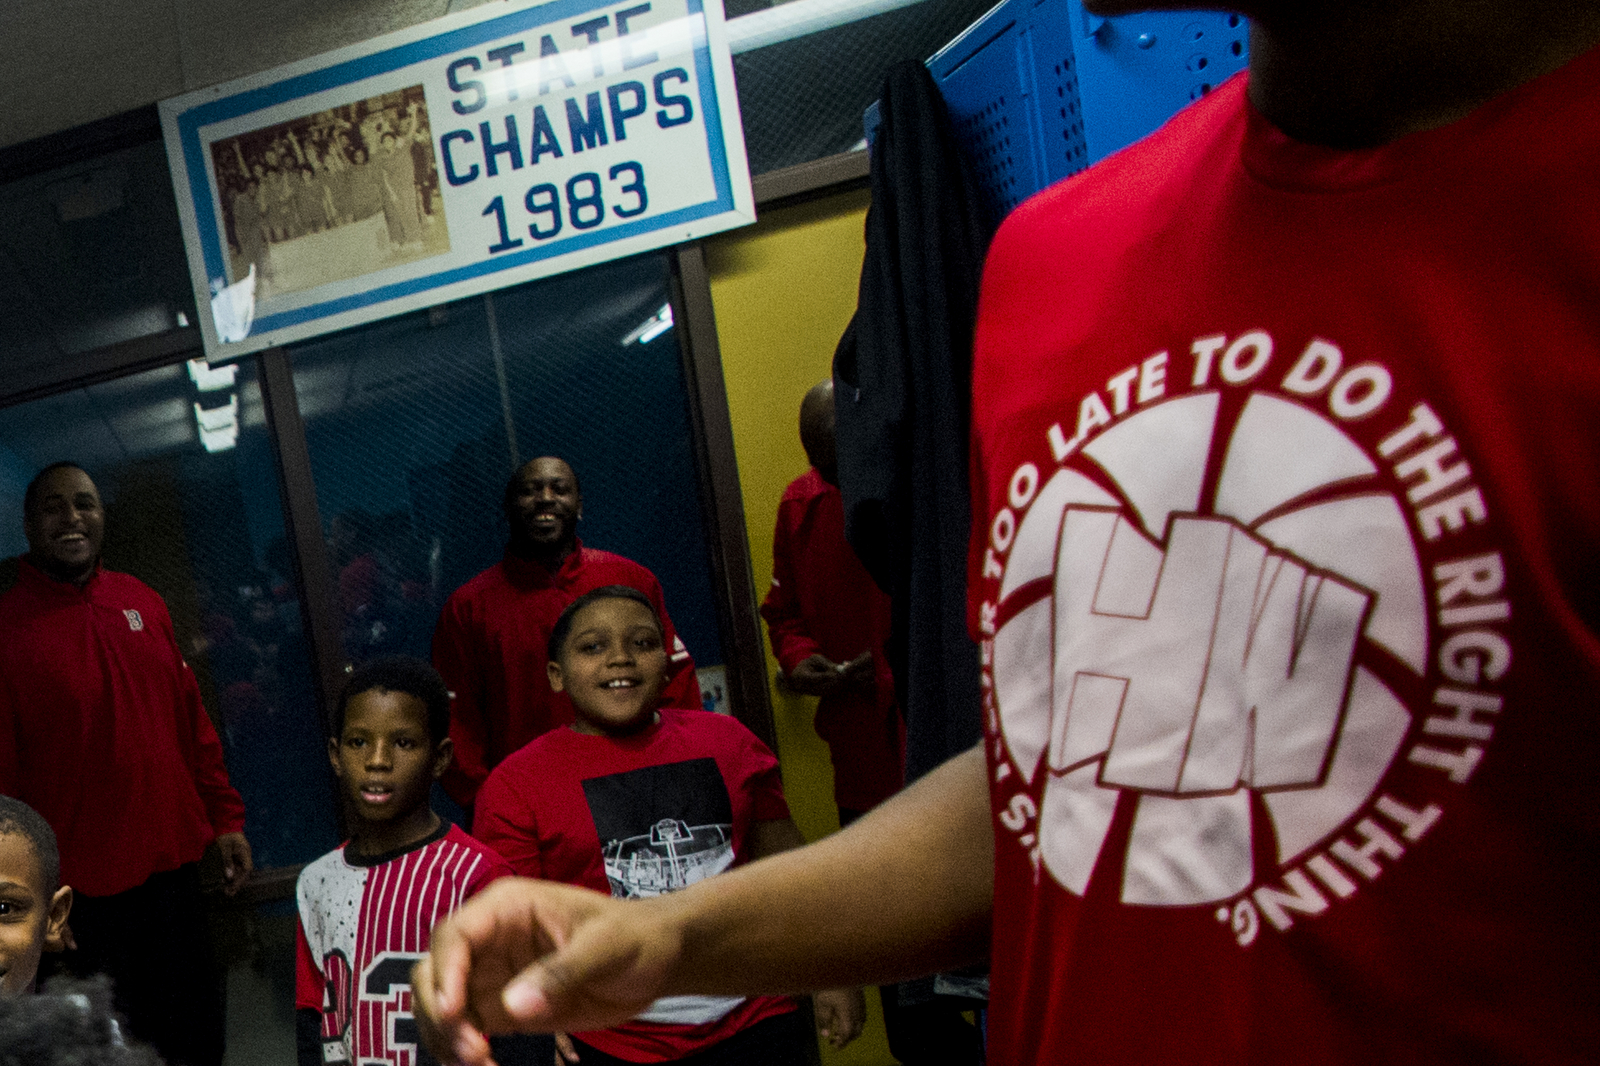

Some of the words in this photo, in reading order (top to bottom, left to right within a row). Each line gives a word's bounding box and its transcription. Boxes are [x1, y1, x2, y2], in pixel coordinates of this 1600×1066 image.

[446, 3, 660, 115] STATE
[440, 67, 694, 187] CHAMPS
[481, 161, 650, 254] 1983
[1048, 352, 1168, 462] LATE
[1191, 329, 1274, 386] TO
[1280, 338, 1394, 420] DO
[983, 462, 1040, 581] TOO
[1377, 403, 1488, 543] THE
[1407, 551, 1513, 785] RIGHT
[1215, 795, 1445, 948] THING.
